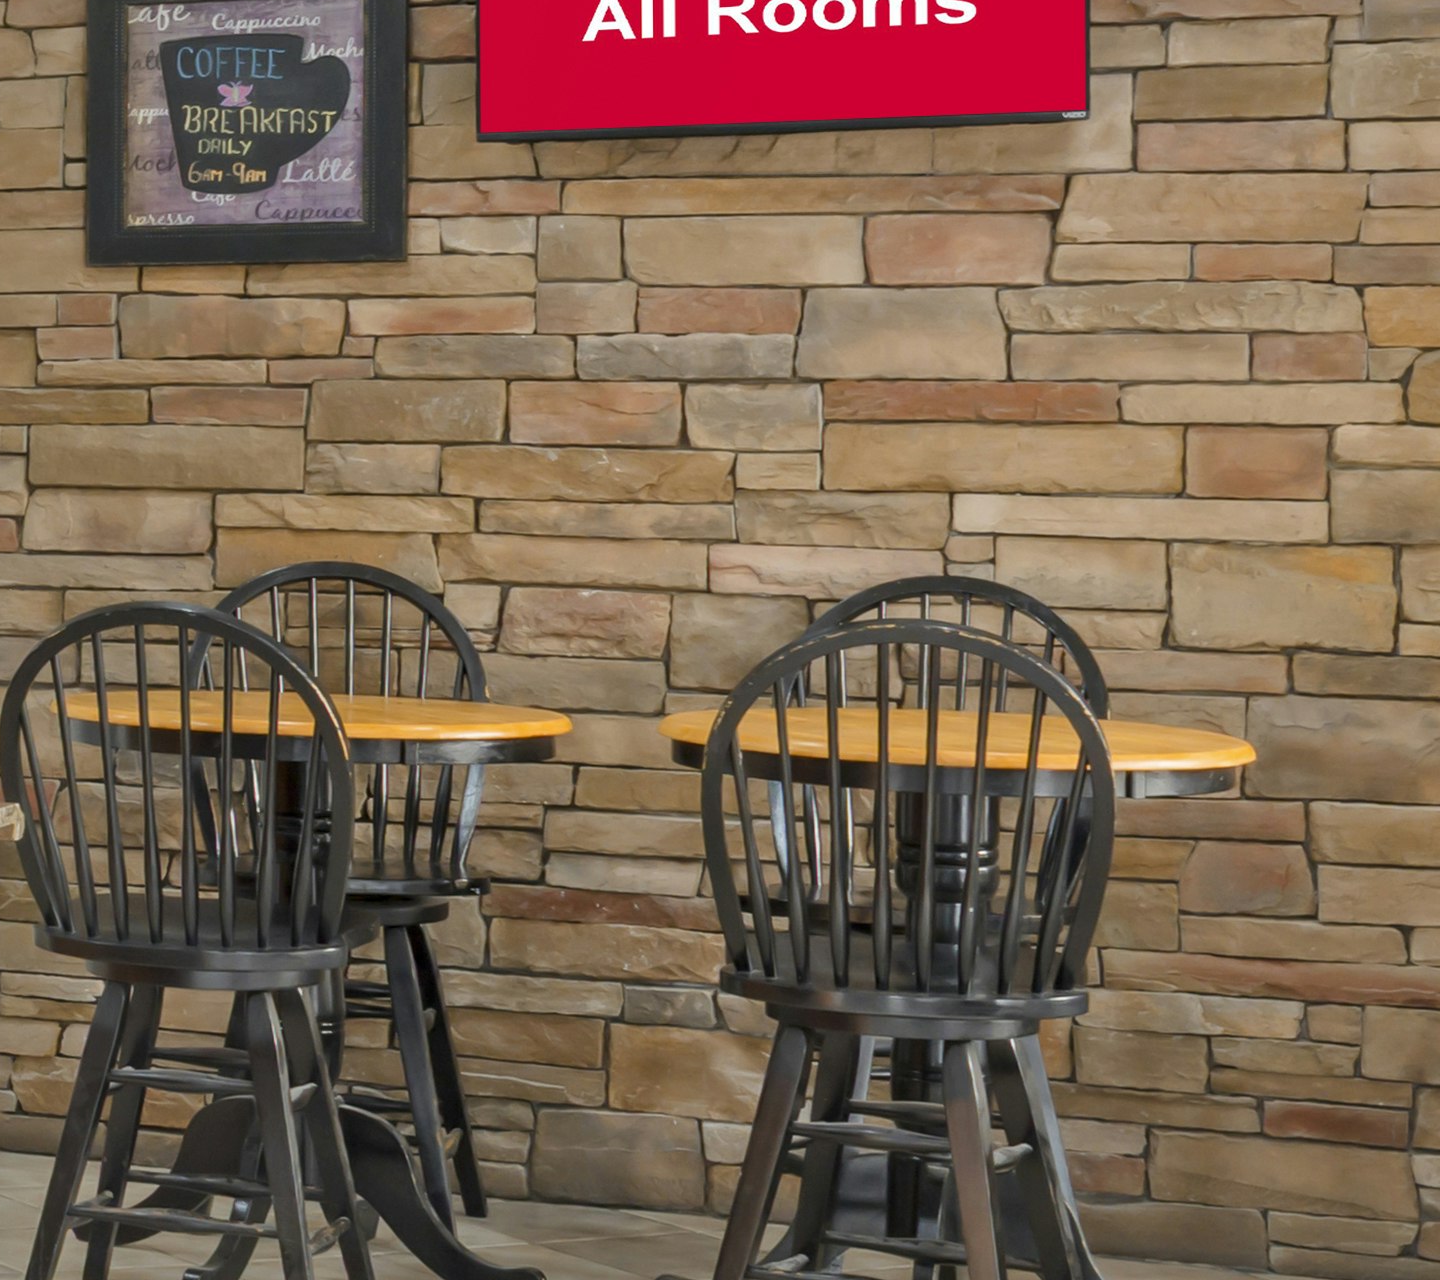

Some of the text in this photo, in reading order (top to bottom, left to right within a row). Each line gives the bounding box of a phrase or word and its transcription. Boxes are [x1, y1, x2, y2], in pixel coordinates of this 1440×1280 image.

[128, 4, 191, 31] afe
[212, 13, 321, 34] Cappuccino
[177, 46, 286, 79] COFFEE
[182, 105, 337, 134] BREAKFAST
[198, 138, 252, 155] DAILY
